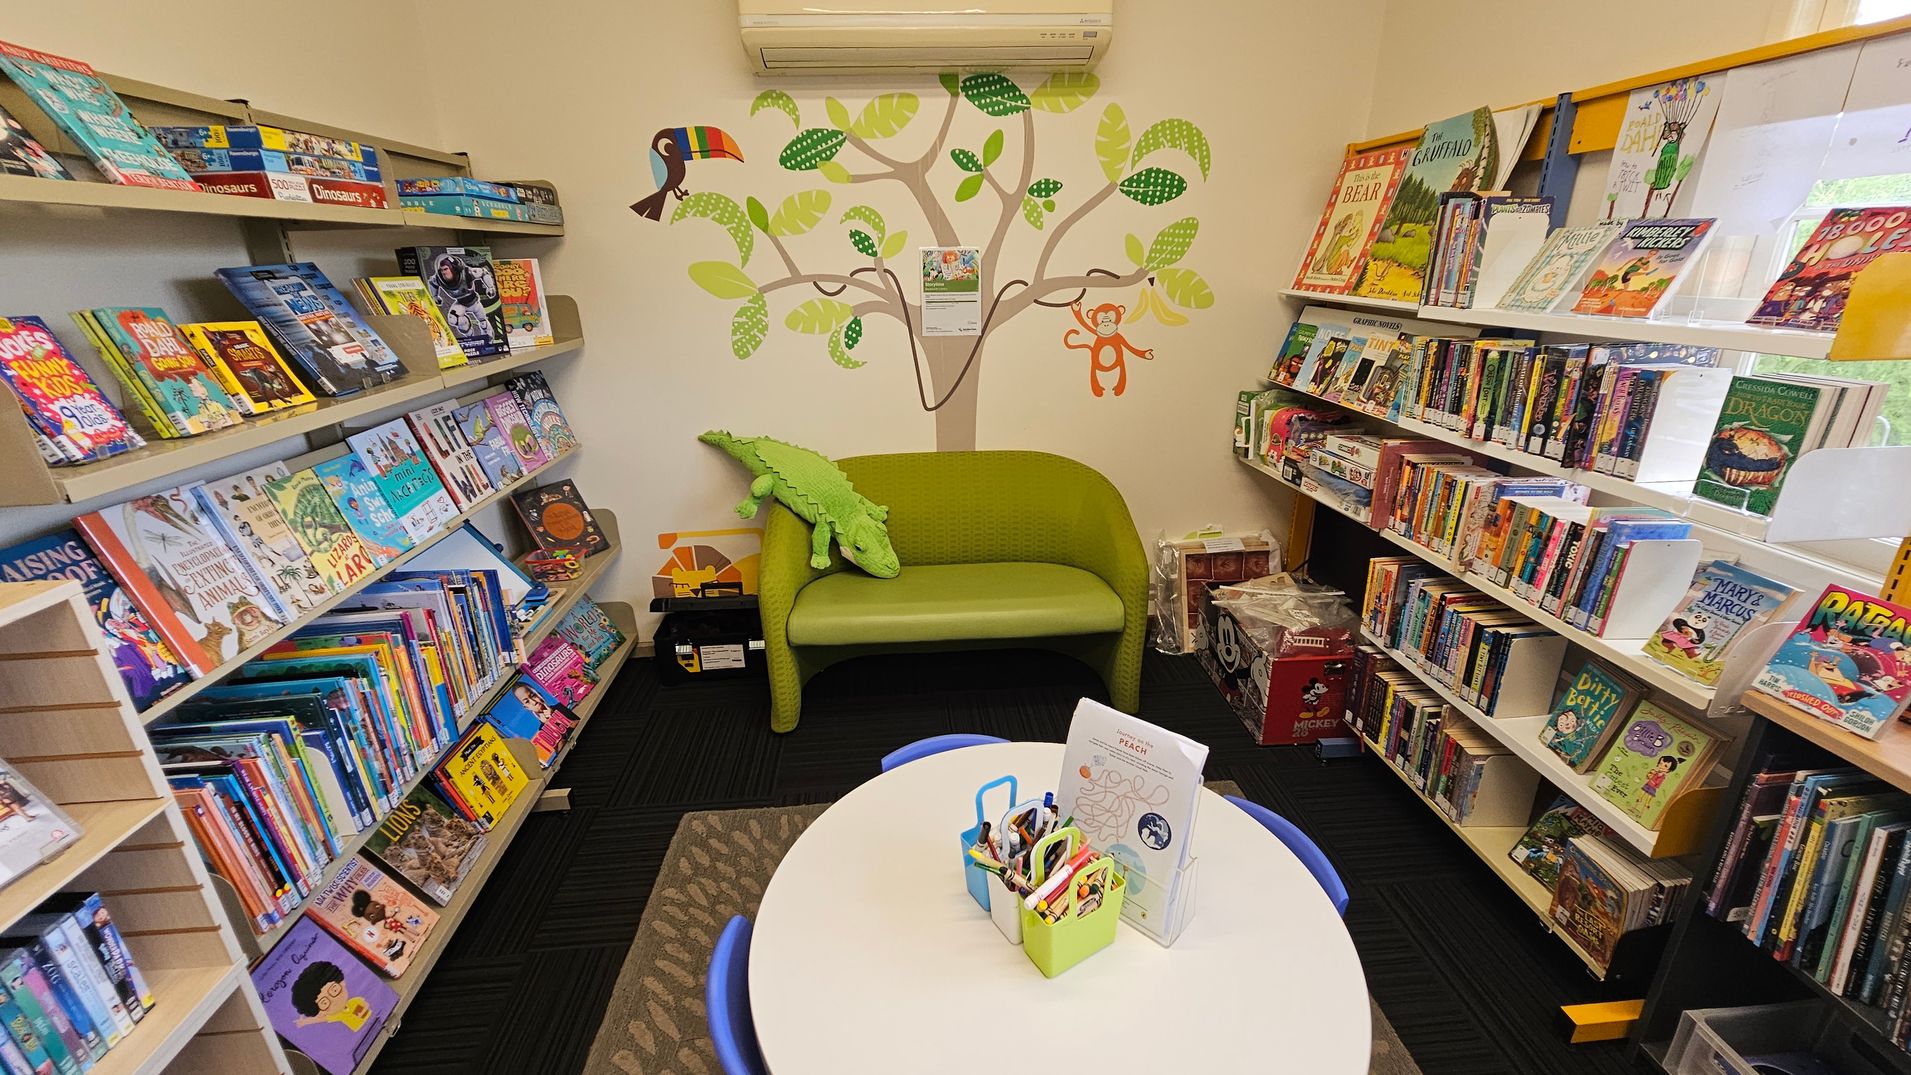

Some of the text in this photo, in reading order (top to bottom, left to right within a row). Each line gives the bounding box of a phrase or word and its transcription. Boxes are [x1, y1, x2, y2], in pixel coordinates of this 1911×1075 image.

[1431, 132, 1444, 142] THE
[1412, 139, 1472, 167] GRUFFALO
[200, 181, 259, 194] Dinosaurs
[271, 178, 289, 190] 500
[312, 183, 362, 203] Dinosaurs
[1342, 182, 1382, 204] BEAR
[1522, 203, 1551, 215] ZOMBIES
[1626, 224, 1696, 240] KIMBERLEY
[1637, 236, 1692, 250] KICKERS
[283, 295, 327, 315] NEWS
[129, 322, 174, 338] ROALD
[1352, 316, 1402, 332] GRAPHIC NOVELS
[142, 337, 187, 358] DAHL
[9, 356, 72, 383] FUNNY
[1735, 380, 1818, 400] CRESSIDA COWELL
[73, 403, 97, 416] Year
[1724, 396, 1810, 428] DRAGON
[363, 494, 386, 510] Swi
[0, 541, 87, 582] AISING
[327, 533, 358, 570] LIZARDS
[1564, 540, 1581, 570] TOXIC
[197, 572, 253, 611] ANIMALS
[1713, 577, 1765, 606] MARY &
[1697, 590, 1759, 622] MARCUS
[1808, 590, 1911, 645] RATBA
[536, 645, 574, 682] DINOSAURS
[1757, 679, 1782, 694] HARRIS
[1767, 674, 1782, 684] TIM
[1576, 672, 1621, 711] Dirty
[1566, 687, 1607, 730] Bertie
[1849, 709, 1876, 726] SHILOH
[1294, 718, 1340, 730] MICKEY
[1633, 723, 1654, 742] Billie
[1843, 716, 1872, 734] GORDON
[1118, 738, 1148, 756] PEACH
[1609, 763, 1624, 777] The
[1610, 784, 1629, 799] Ever
[379, 799, 421, 842] LIONS
[335, 878, 359, 903] WHY
